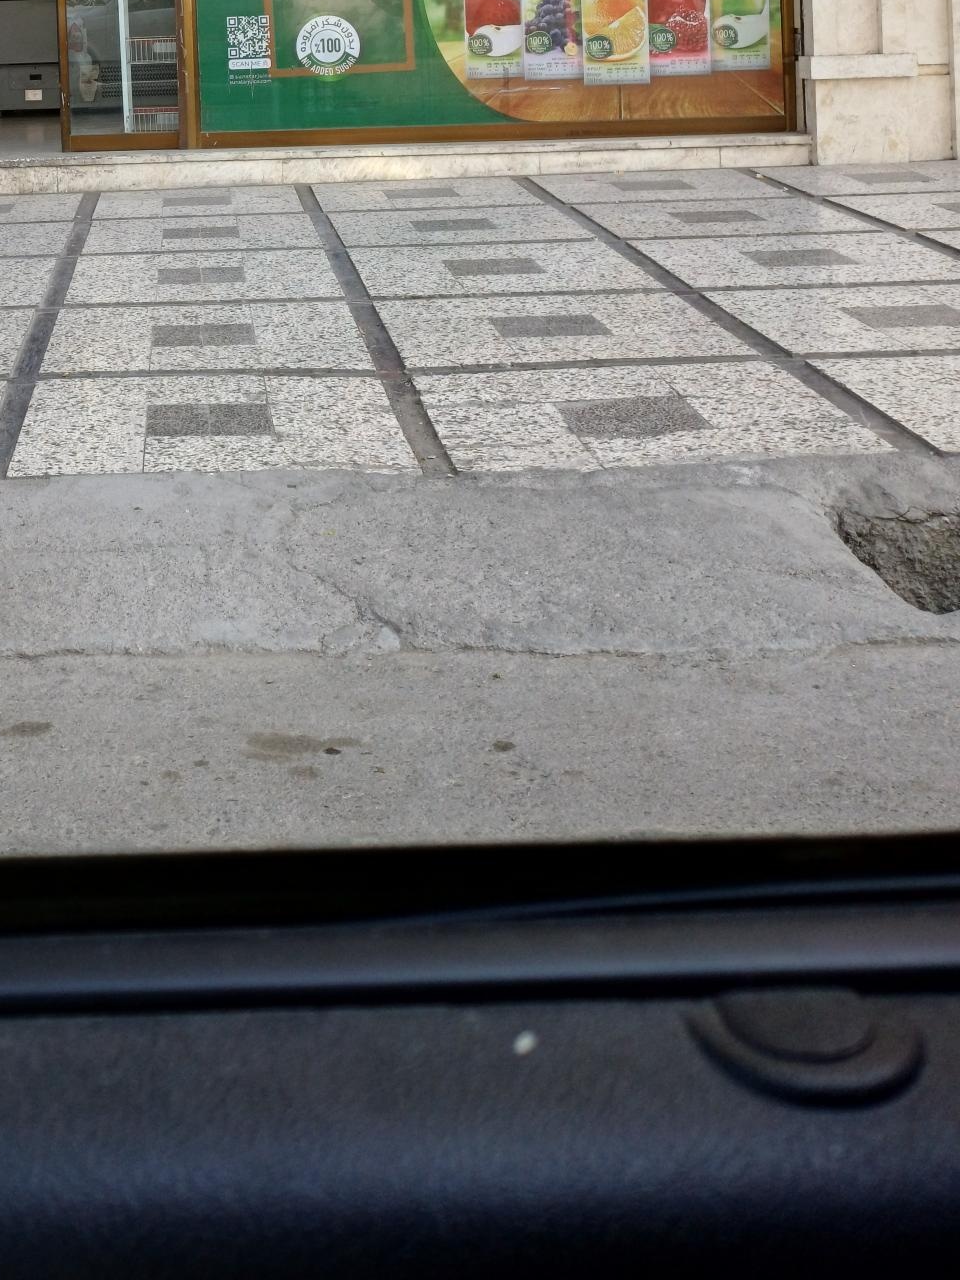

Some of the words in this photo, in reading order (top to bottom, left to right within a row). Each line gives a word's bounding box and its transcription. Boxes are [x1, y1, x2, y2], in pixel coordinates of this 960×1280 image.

[528, 35, 551, 46] 100%
[652, 32, 674, 42] 100%
[470, 38, 491, 48] 100%
[588, 40, 611, 50] 100%
[301, 57, 312, 68] NO
[310, 64, 334, 76] ADDED
[335, 56, 357, 74] SUGAR
